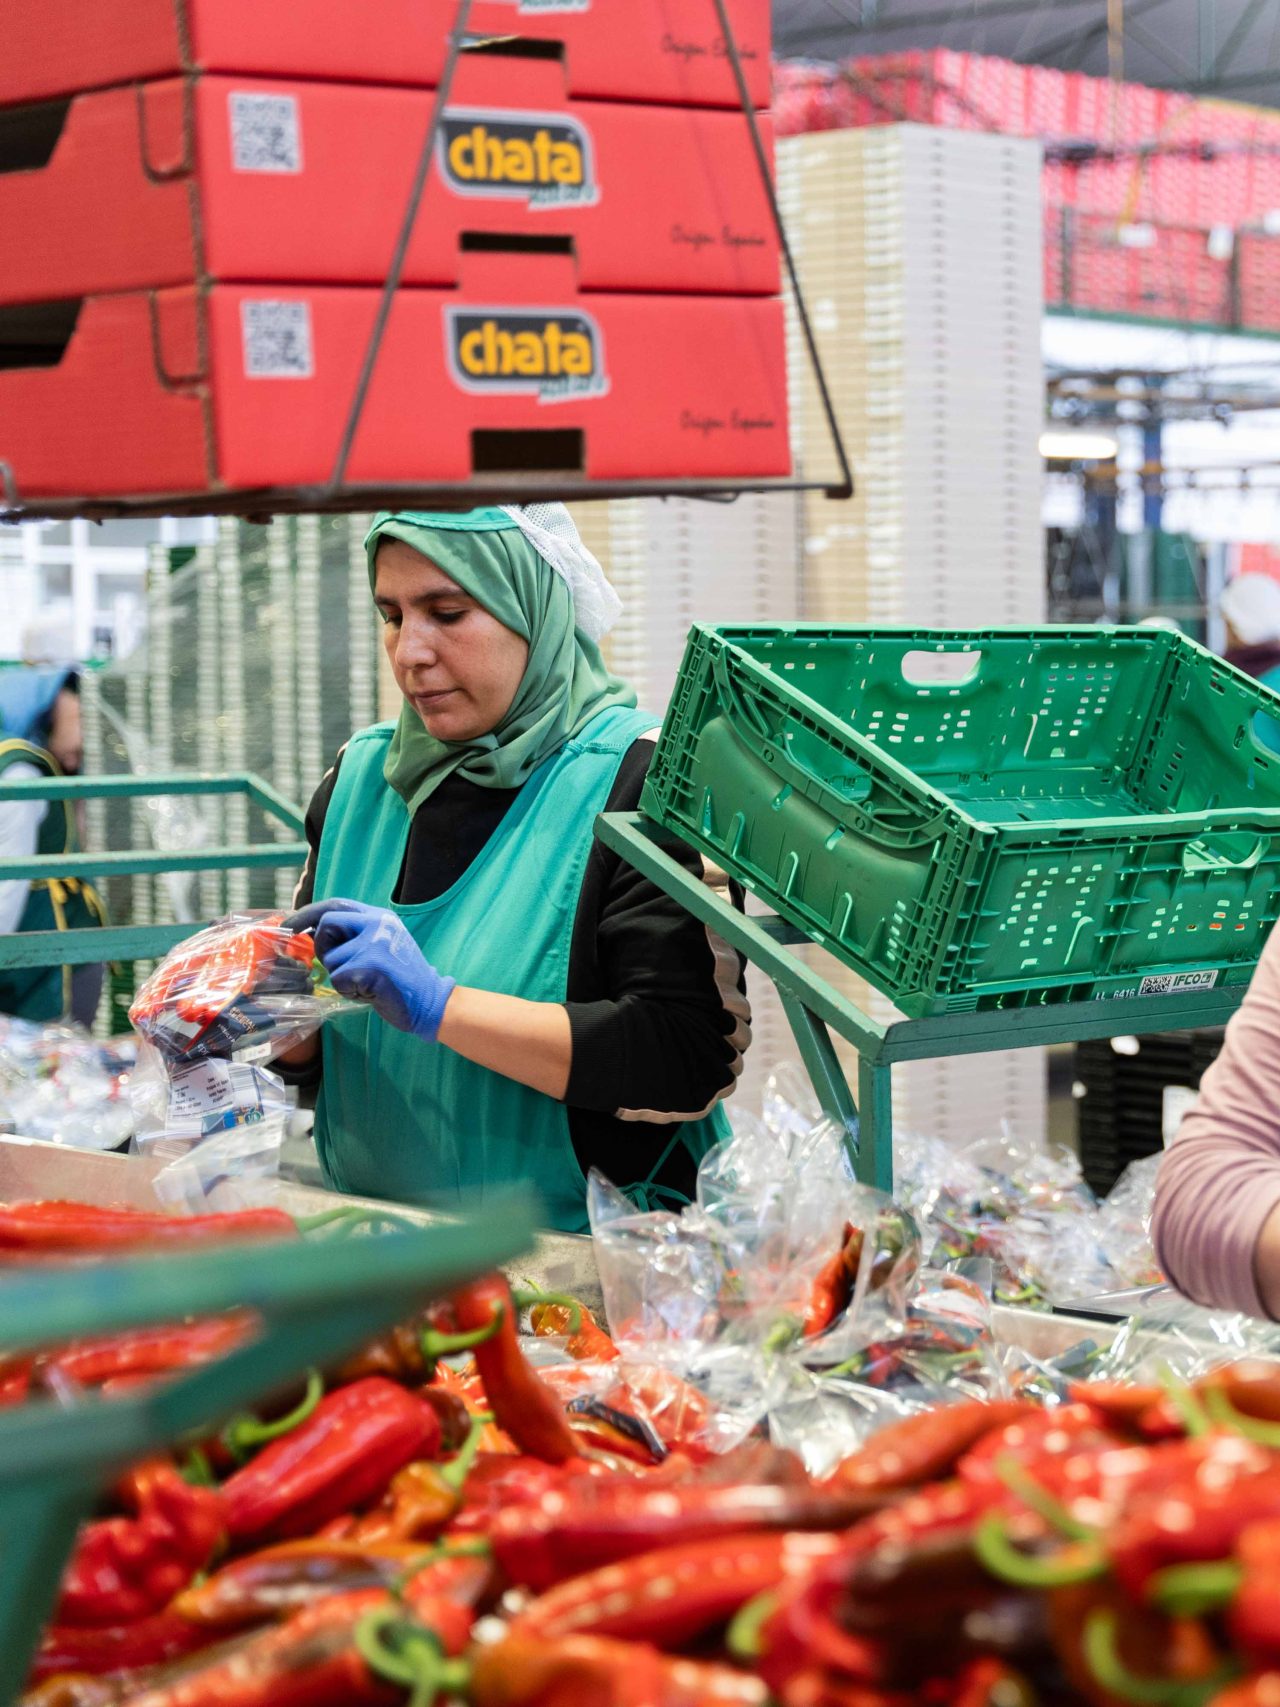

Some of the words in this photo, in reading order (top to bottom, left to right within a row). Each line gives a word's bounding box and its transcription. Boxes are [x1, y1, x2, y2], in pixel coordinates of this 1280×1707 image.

[450, 126, 583, 184] chata
[460, 321, 592, 375] chata
[1113, 988, 1135, 999] 6416
[1173, 974, 1201, 986] IFCO
